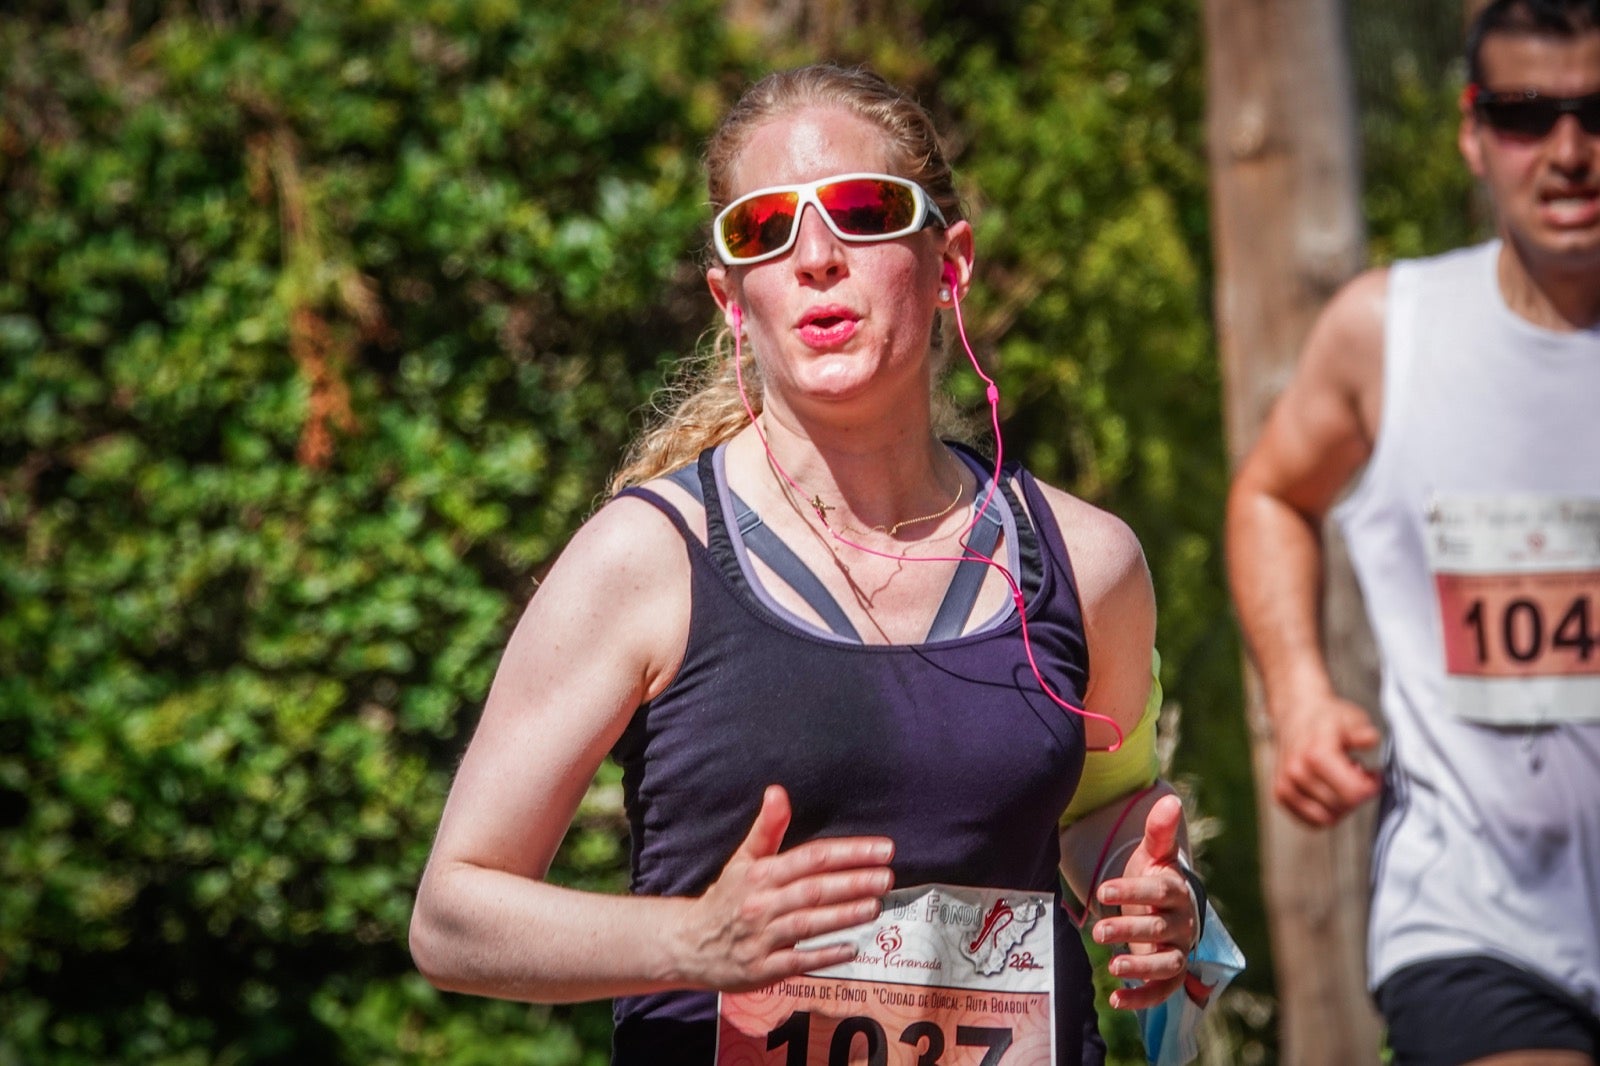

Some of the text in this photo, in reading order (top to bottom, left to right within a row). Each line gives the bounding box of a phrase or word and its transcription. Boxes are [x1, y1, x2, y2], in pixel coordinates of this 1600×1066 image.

[1464, 595, 1600, 664] 104
[850, 951, 942, 970] abor Granada
[778, 980, 816, 999] PRUEBA
[819, 986, 834, 1000] DE
[835, 984, 868, 1003] FONDO
[918, 996, 930, 1009] DE
[966, 995, 988, 1013] RUTA
